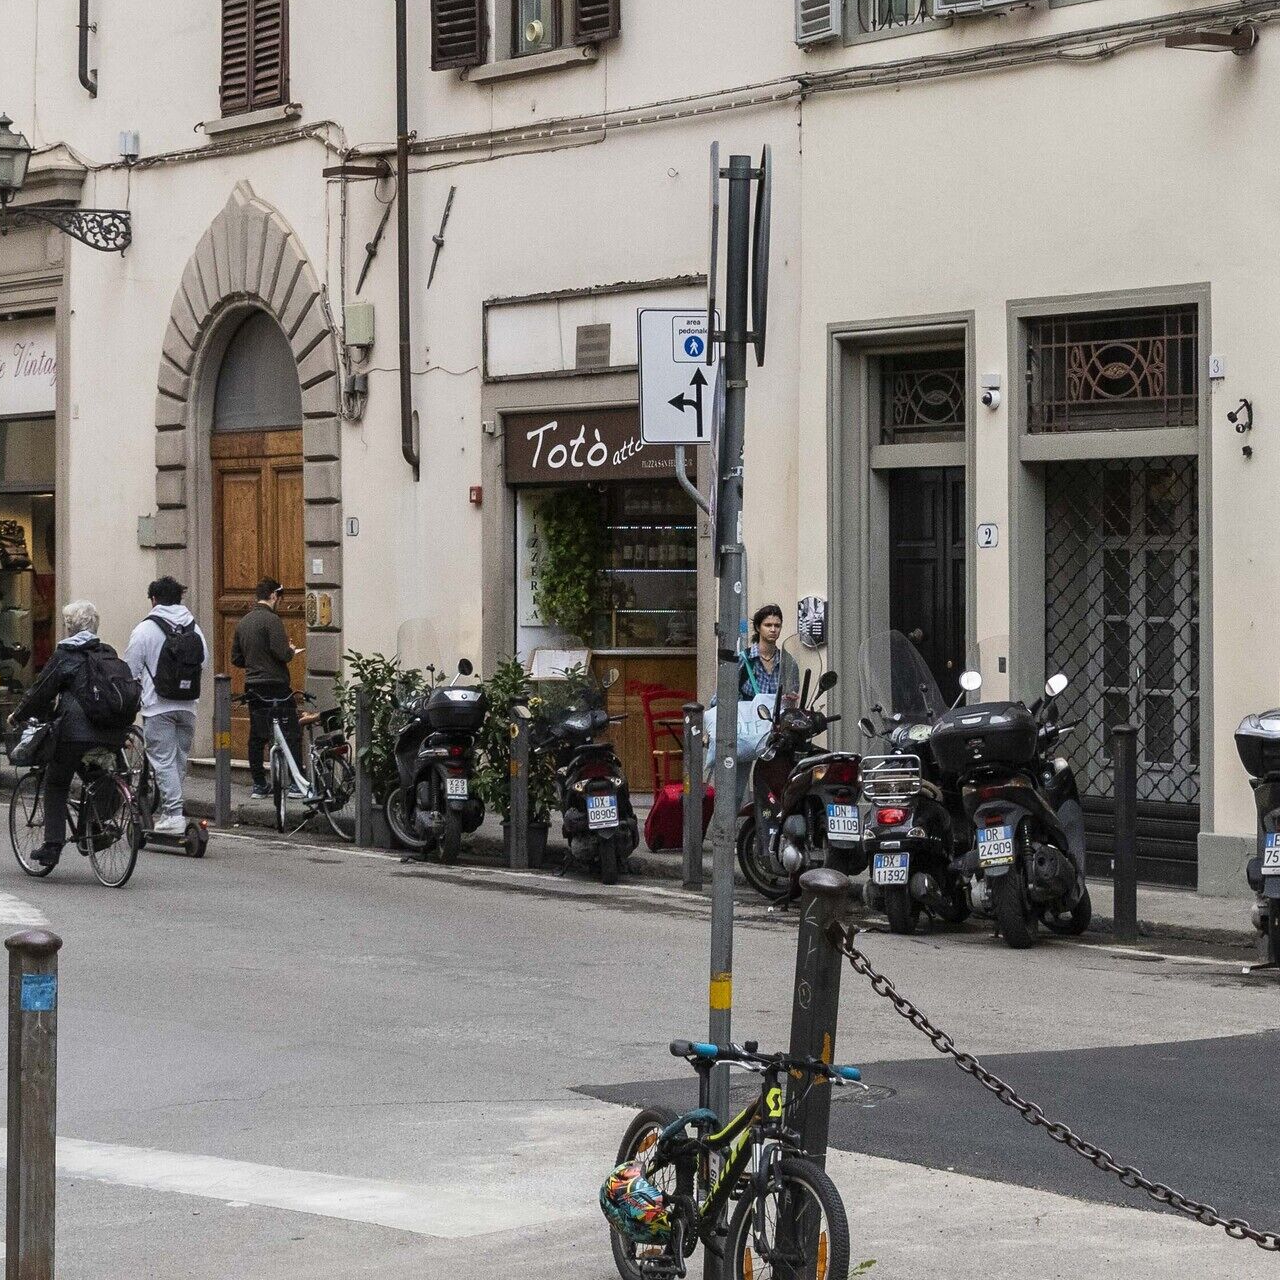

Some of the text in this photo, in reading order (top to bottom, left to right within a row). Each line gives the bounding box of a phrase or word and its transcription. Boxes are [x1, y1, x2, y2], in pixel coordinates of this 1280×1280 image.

[1212, 359, 1220, 374] 3
[526, 420, 609, 469] Totò
[350, 520, 355, 534] 1
[984, 527, 992, 545] 2
[530, 510, 539, 620] PIZZERIA
[594, 797, 605, 808] DX
[590, 809, 617, 821] 08905
[835, 805, 847, 817] DN
[829, 818, 858, 831] 81109
[985, 828, 999, 841] DR
[980, 841, 1012, 857] 24909
[883, 855, 896, 868] DX
[877, 869, 906, 882] 11392
